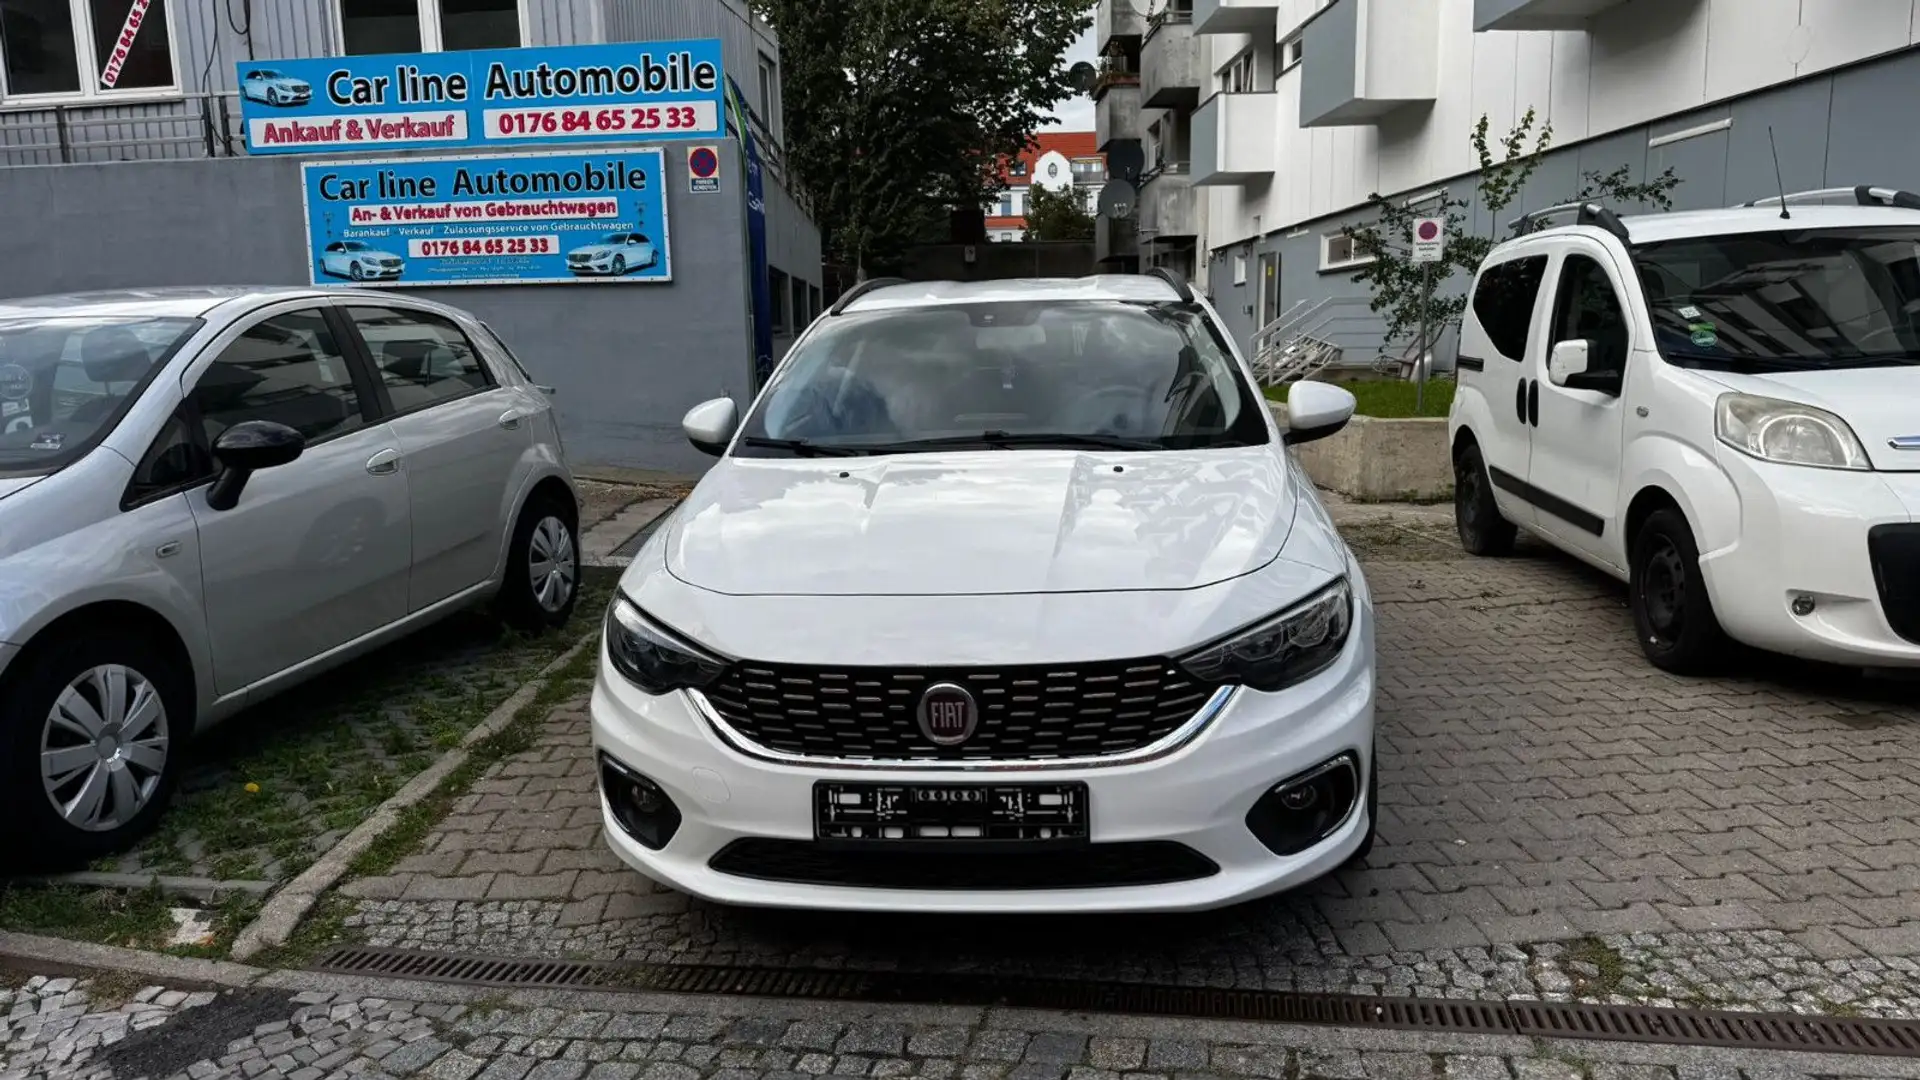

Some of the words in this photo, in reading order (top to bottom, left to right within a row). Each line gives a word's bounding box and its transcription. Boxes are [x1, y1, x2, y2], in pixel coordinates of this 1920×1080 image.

[104, 47, 126, 83] 0176
[120, 28, 135, 48] 84
[128, 8, 143, 29] 65
[328, 69, 388, 105] Car
[397, 65, 467, 102] line
[485, 52, 717, 99] Automobile
[264, 118, 341, 144] Ankauf
[346, 119, 363, 141] &
[365, 114, 455, 140] Verkauf
[499, 111, 557, 134] 0176
[561, 110, 591, 131] 84
[596, 109, 626, 130] 65
[631, 107, 661, 129] 25
[666, 106, 696, 128] 33
[320, 173, 369, 200] Car
[377, 170, 436, 199] line
[453, 161, 646, 196] Automobile
[352, 206, 377, 221] An-
[380, 206, 392, 221] &
[393, 203, 452, 220] Verkauf
[452, 206, 482, 218] von
[485, 200, 616, 218] Gebrauchtwagen
[343, 227, 390, 237] Barankauf
[398, 226, 434, 236] Verkauf
[443, 223, 529, 236] Zulassungsservice
[531, 223, 549, 232] von
[550, 221, 634, 233] Gebrauchtwagen
[421, 240, 459, 256] 0176
[462, 240, 482, 255] 84
[484, 239, 504, 254] 65
[507, 238, 527, 253] 25
[530, 237, 549, 253] 33
[931, 701, 965, 728] FIAT
